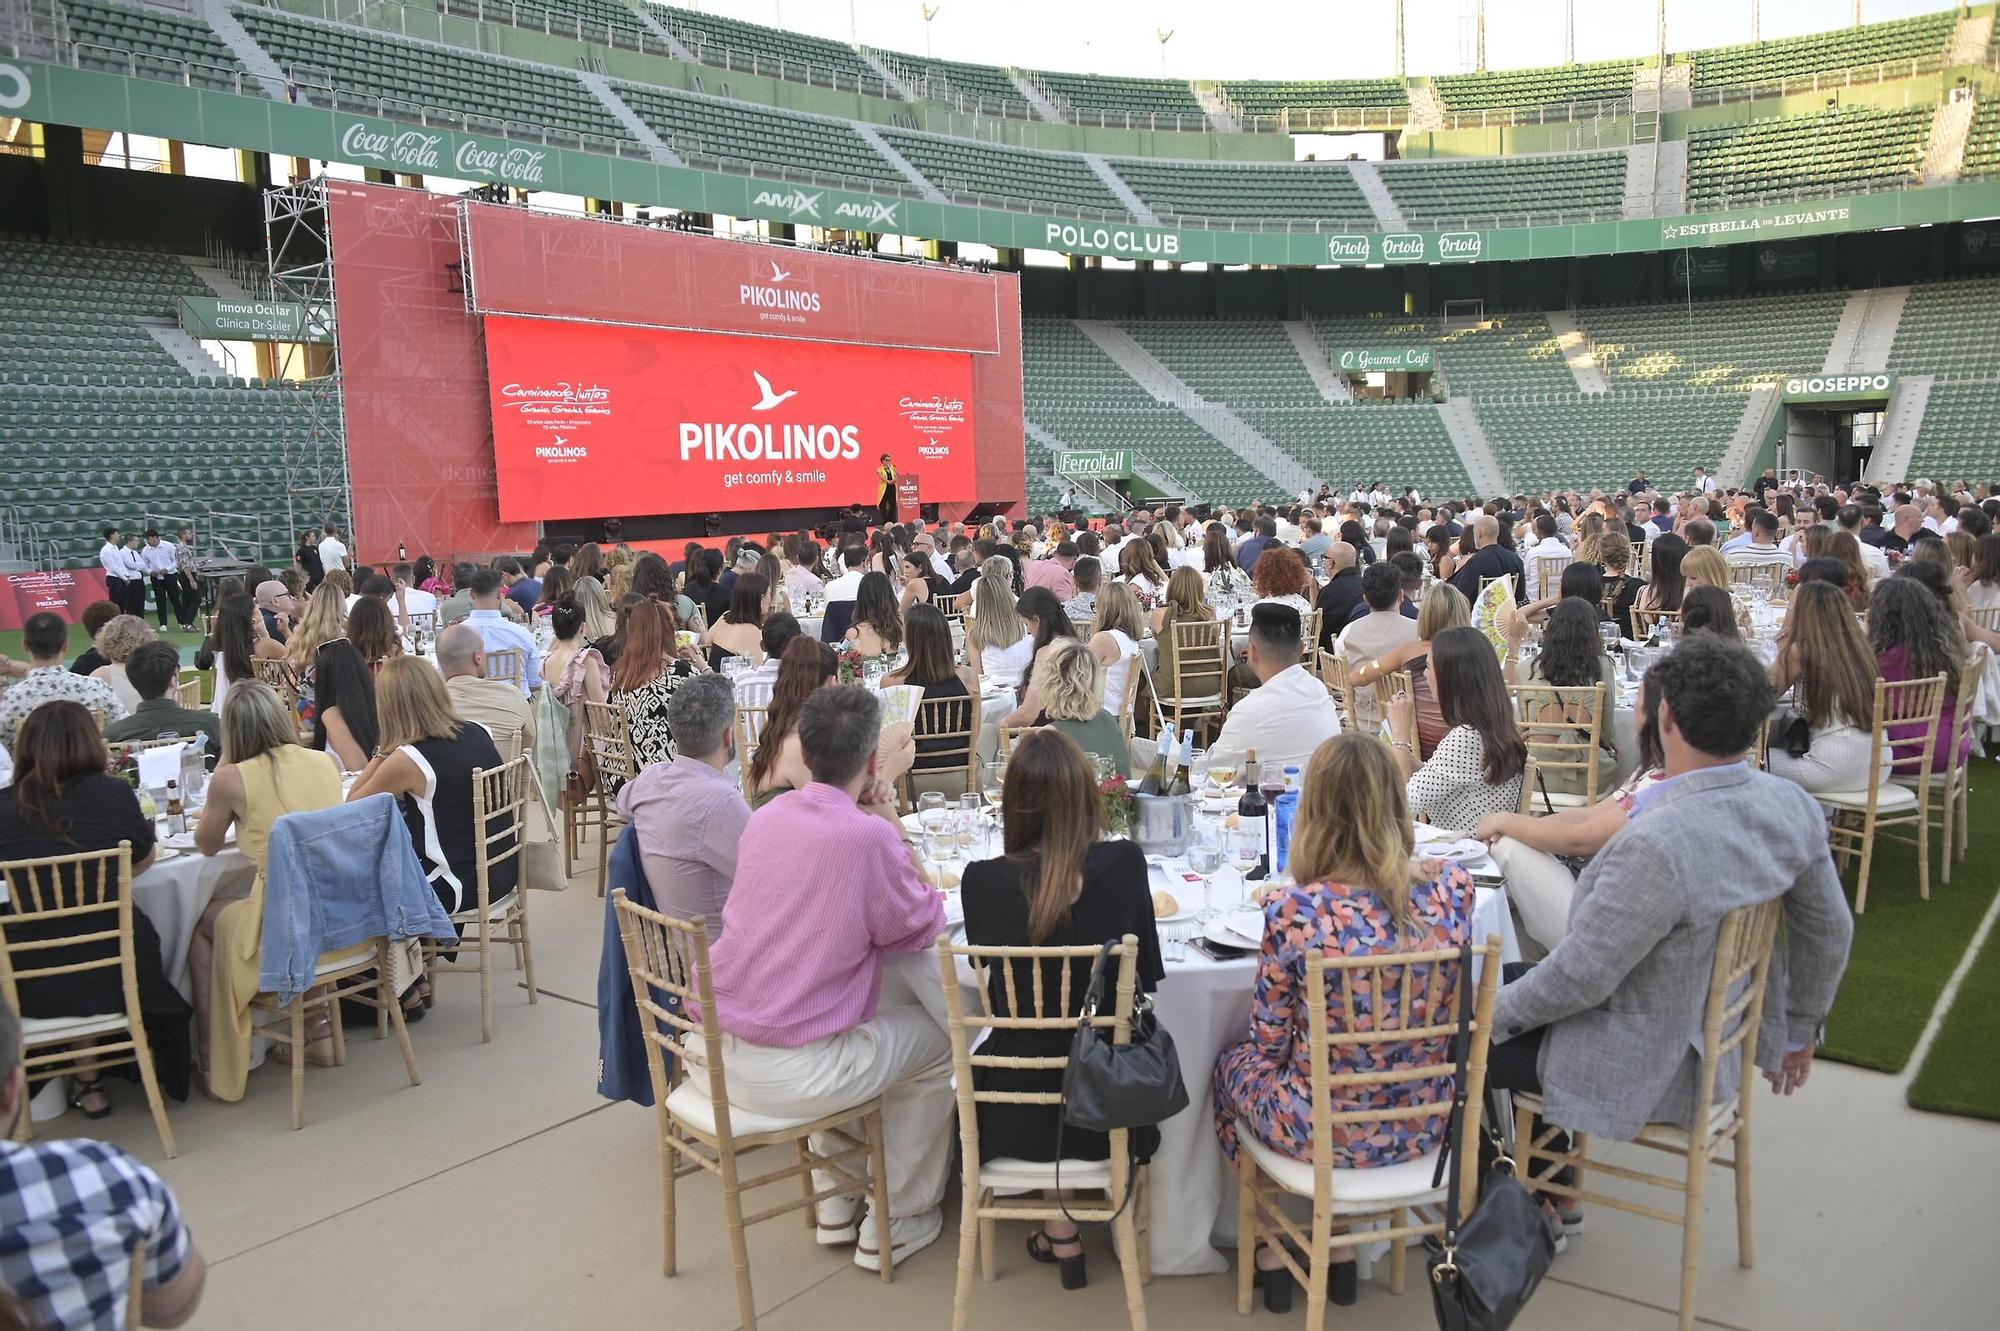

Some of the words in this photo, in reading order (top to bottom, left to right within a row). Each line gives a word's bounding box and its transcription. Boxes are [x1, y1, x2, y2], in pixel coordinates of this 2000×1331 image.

[1679, 218, 1760, 236] ESTRELLA
[1774, 208, 1849, 227] LEVANTE
[1047, 223, 1110, 249] POLO
[1113, 231, 1179, 254] CLUB
[217, 301, 253, 314] Innova
[740, 284, 821, 312] PIKOLINOS
[1359, 350, 1401, 369] Gourmet
[1406, 349, 1430, 367] Café
[1786, 375, 1889, 394] GIOSEPPO
[679, 422, 861, 461] PIKOLINOS
[535, 447, 587, 457] PIKOLINOS
[724, 471, 743, 487] get
[746, 469, 782, 486] comfy
[785, 470, 793, 483] &
[796, 469, 826, 483] smile
